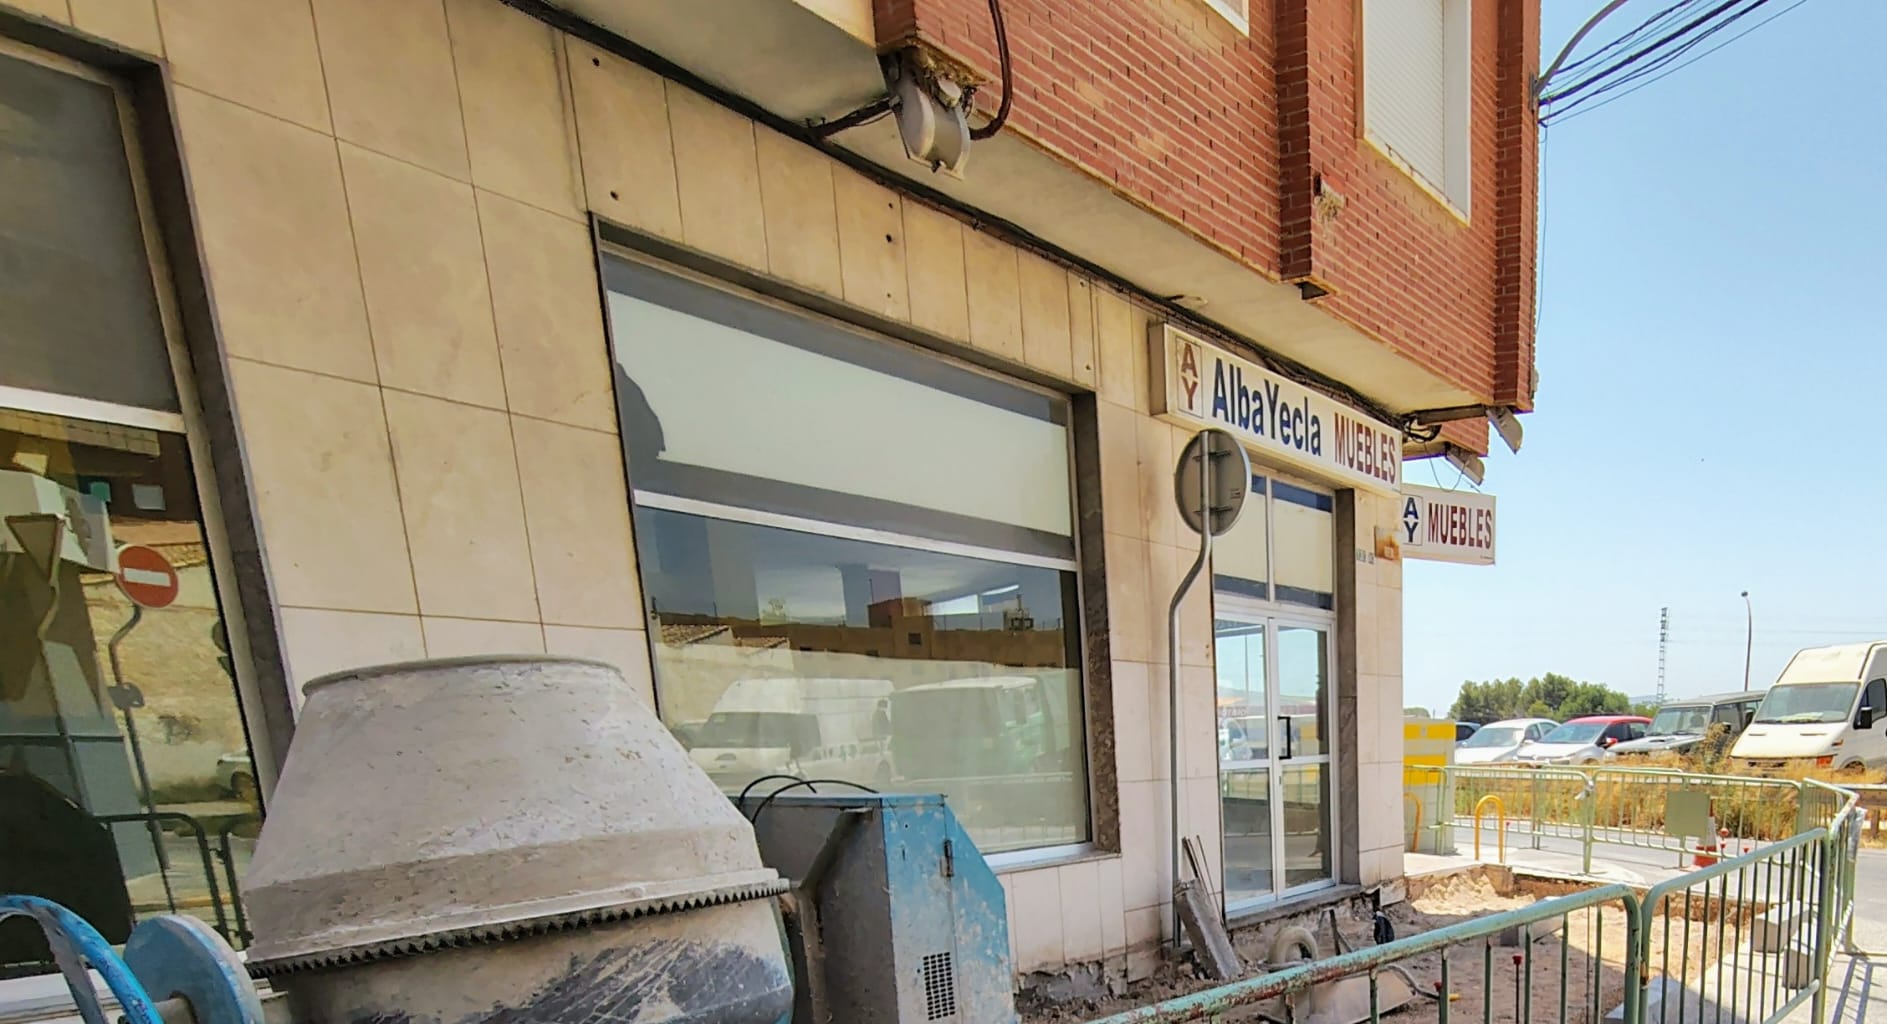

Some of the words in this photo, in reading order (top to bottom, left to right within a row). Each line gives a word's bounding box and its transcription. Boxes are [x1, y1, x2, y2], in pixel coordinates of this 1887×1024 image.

[1212, 357, 1321, 456] AlbaYecla
[1334, 412, 1396, 484] MUEBLES
[1428, 502, 1492, 550] MUEBLES
